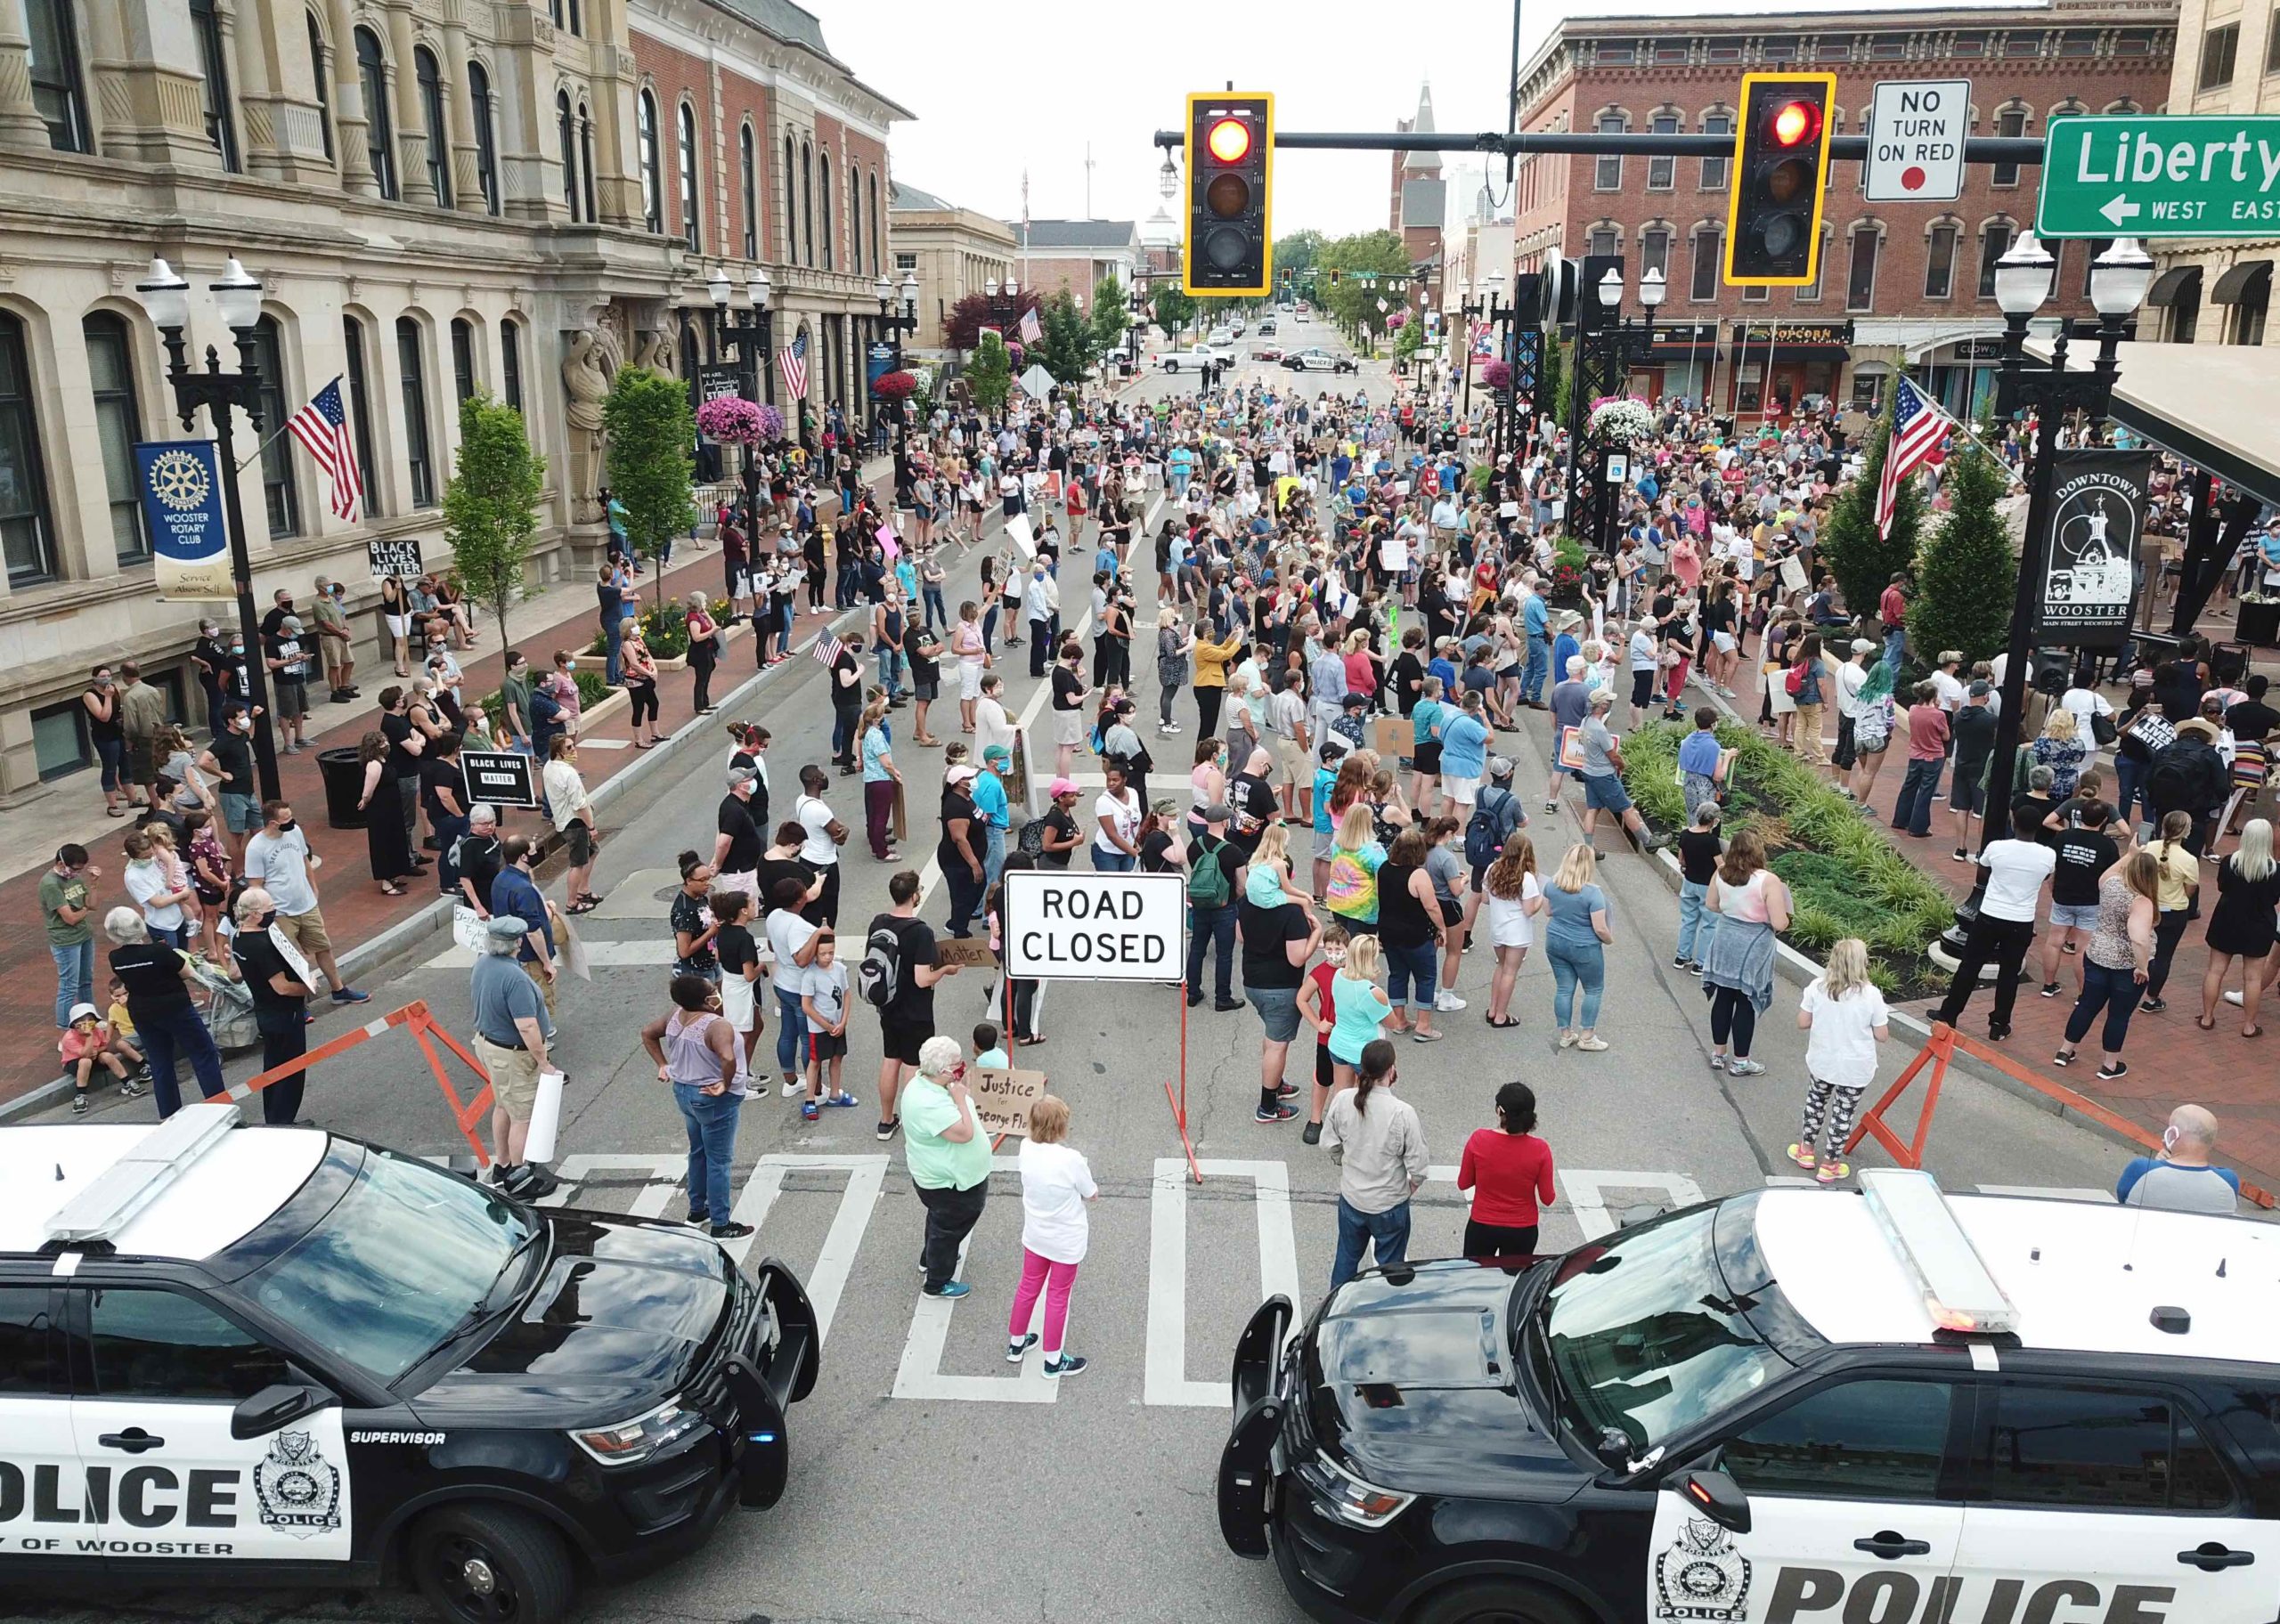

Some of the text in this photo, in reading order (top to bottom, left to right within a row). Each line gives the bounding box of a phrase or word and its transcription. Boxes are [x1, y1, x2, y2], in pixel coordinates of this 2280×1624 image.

[1901, 91, 1941, 112] NO
[1893, 119, 1945, 137] TURN
[1878, 143, 1954, 161] ON RED
[2077, 130, 2280, 192] Liberty
[2152, 200, 2280, 219] WEST EAST
[2055, 473, 2141, 500] DOWNTOWN
[163, 513, 209, 524] WOOSTER
[170, 524, 205, 534] ROTARY
[177, 534, 201, 545] CLUB
[370, 541, 417, 555] BLACK
[376, 553, 415, 564] LIVES
[178, 572, 213, 583] Service
[370, 563, 421, 575] MATTER
[175, 584, 221, 596] Above Self
[2044, 605, 2128, 616] WOOSTER
[2129, 726, 2165, 751] MATT
[2143, 722, 2173, 745] LIVES
[469, 759, 522, 769] BLACK LIVES
[484, 774, 513, 784] MATTER
[269, 842, 300, 865] SEEK JUSTICE
[1043, 889, 1144, 920] ROAD
[940, 946, 985, 963] Matter
[1022, 931, 1165, 963] CLOSED
[981, 1073, 1035, 1097] Justice
[1012, 1113, 1028, 1130] Flo
[351, 1431, 446, 1445] SUPERVISOR
[0, 1461, 240, 1528] LICE
[263, 1514, 338, 1528] POLICE
[21, 1538, 60, 1551] OF
[77, 1539, 233, 1555] WOOSTER
[1657, 1607, 1745, 1620] POLICE
